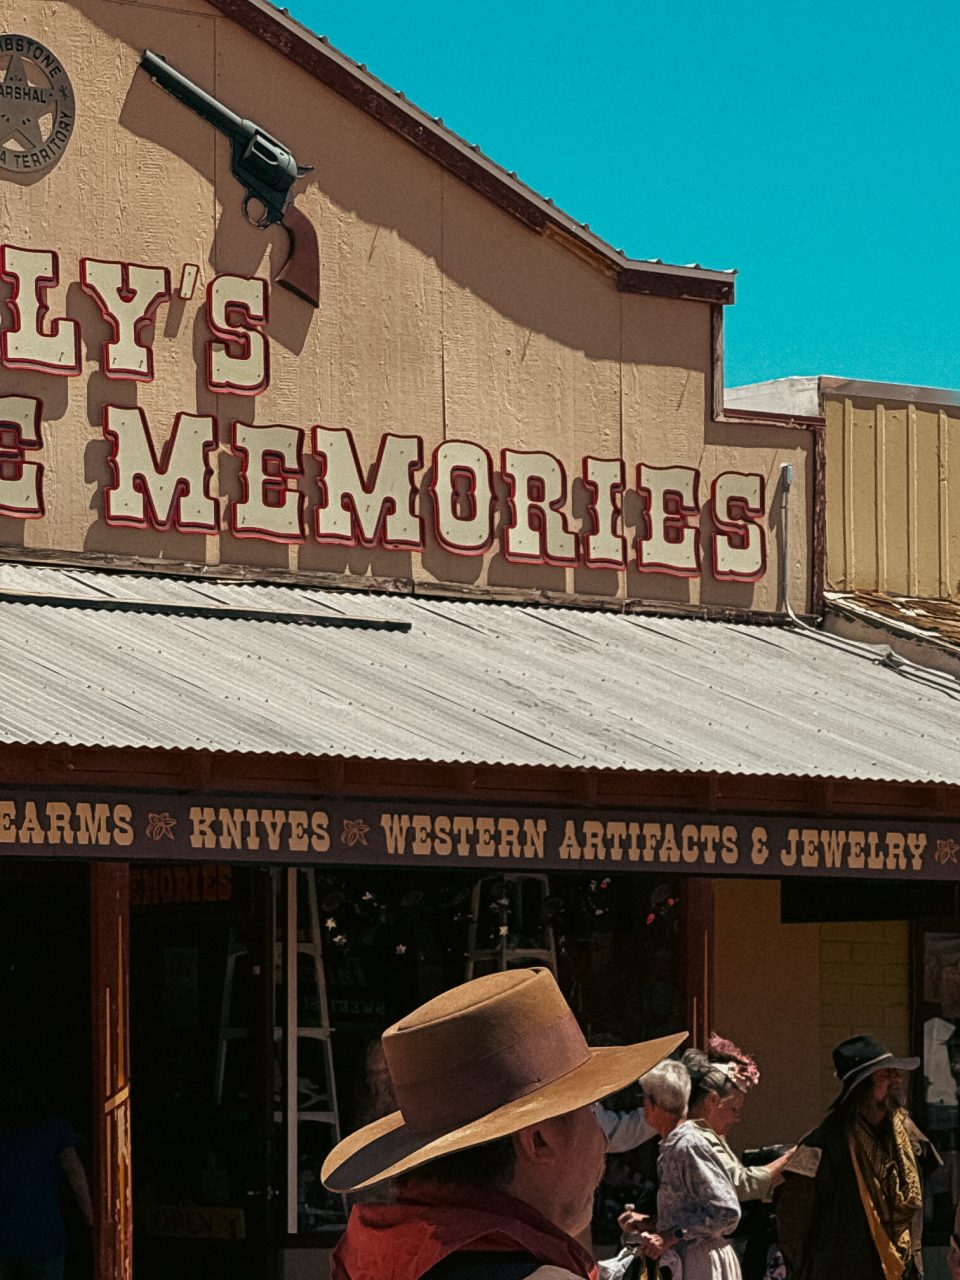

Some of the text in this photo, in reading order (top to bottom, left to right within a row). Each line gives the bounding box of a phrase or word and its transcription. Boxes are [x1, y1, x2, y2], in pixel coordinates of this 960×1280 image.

[0, 38, 61, 79] BSTONE
[14, 111, 73, 169] TERRITORY
[104, 405, 768, 582] MEMORIES
[0, 801, 135, 846] EARMS
[189, 806, 331, 853] KNIVES
[380, 813, 548, 859] WESTERN
[558, 819, 738, 866] ARTIFACTS
[751, 826, 769, 866] &
[780, 828, 927, 871] JEWELRY
